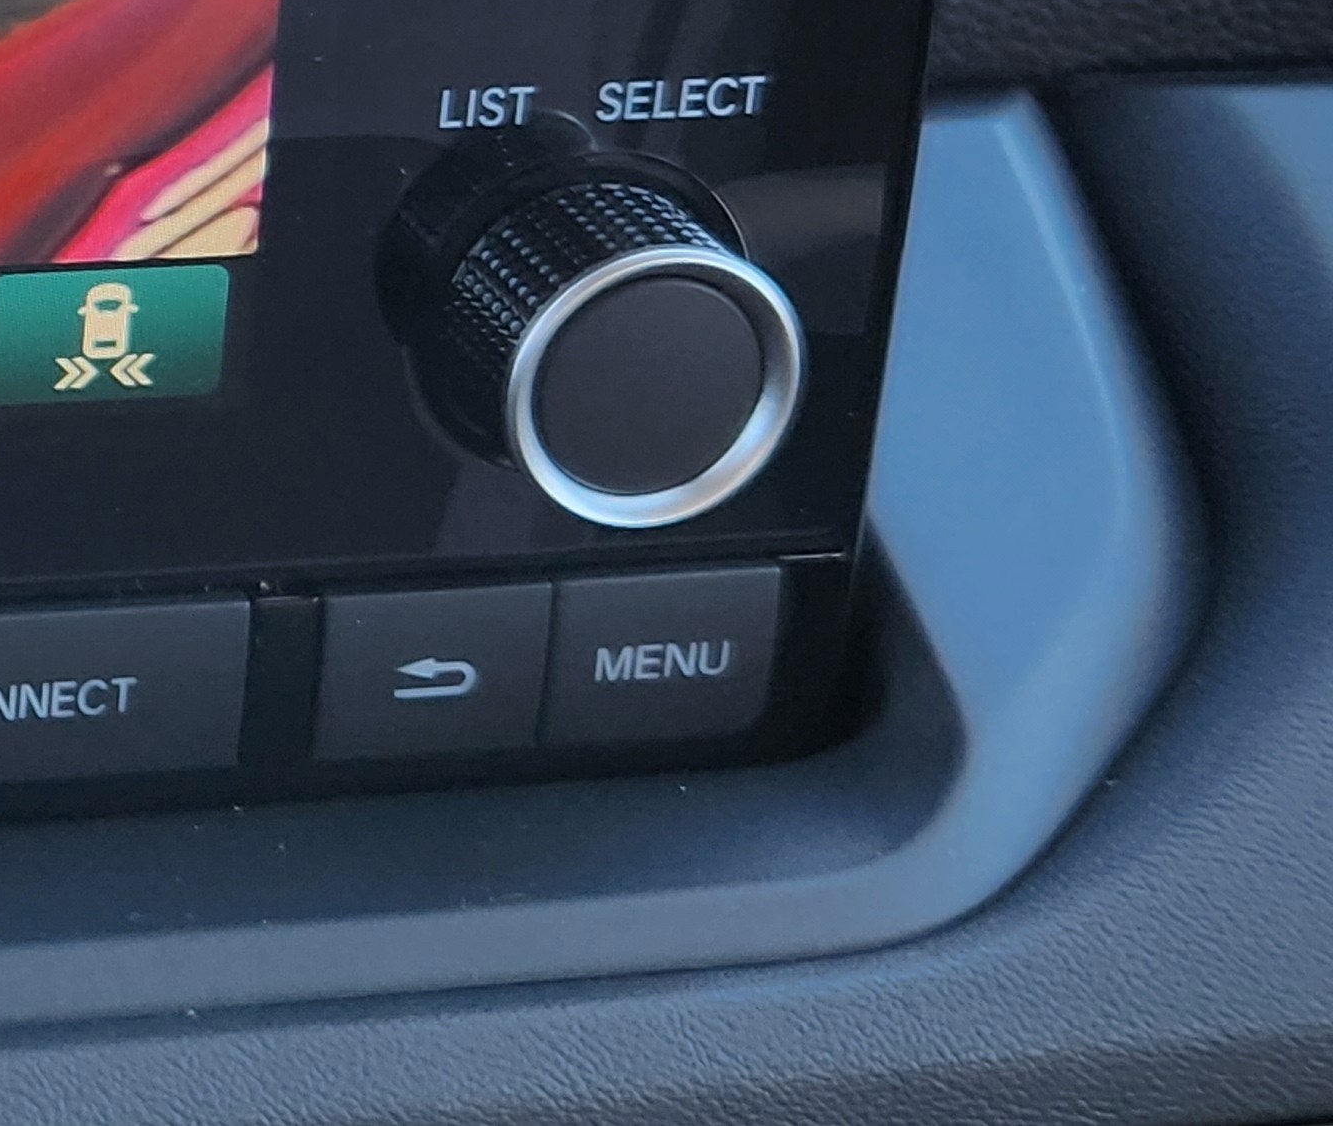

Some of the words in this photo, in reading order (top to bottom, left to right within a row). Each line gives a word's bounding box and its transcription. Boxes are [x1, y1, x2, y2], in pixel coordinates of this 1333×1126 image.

[438, 86, 536, 129] LIST
[595, 75, 766, 122] SELECT
[594, 641, 731, 685] MENU
